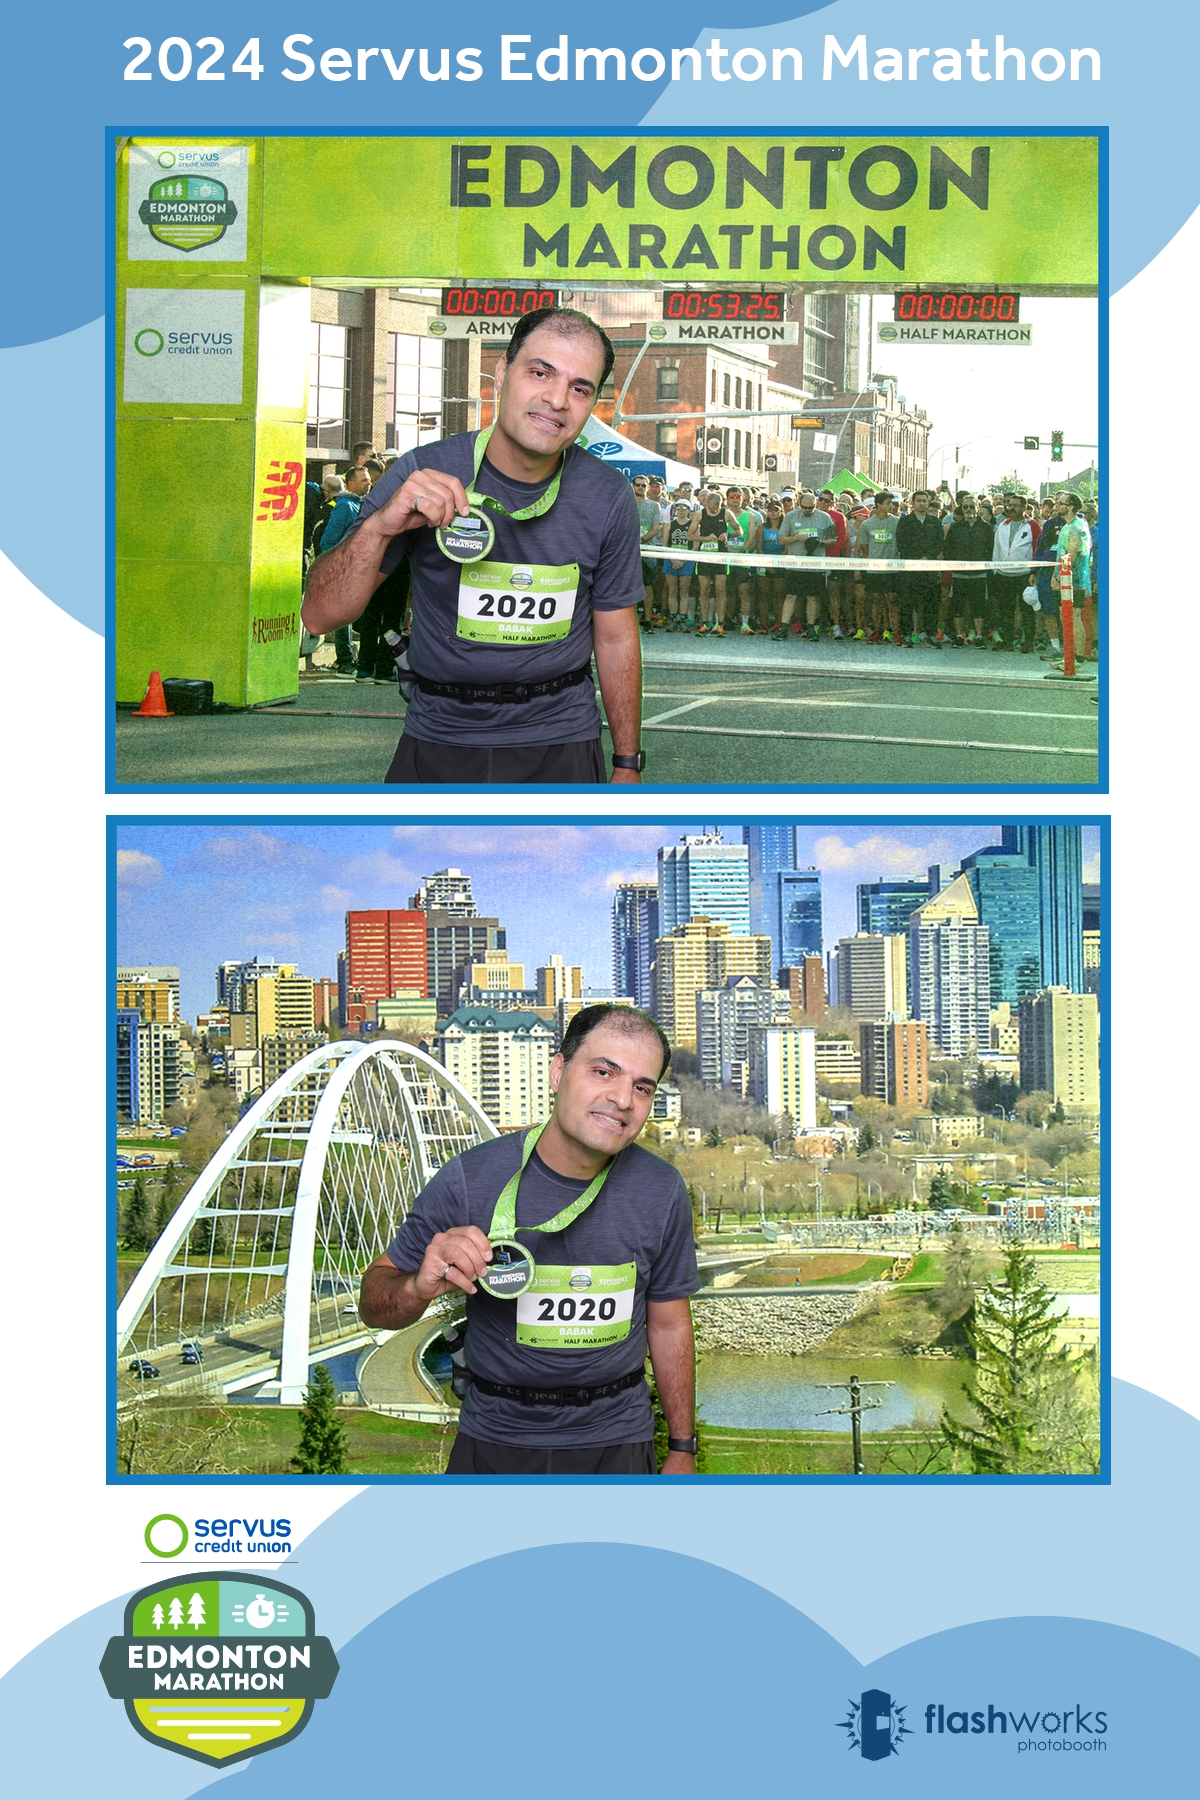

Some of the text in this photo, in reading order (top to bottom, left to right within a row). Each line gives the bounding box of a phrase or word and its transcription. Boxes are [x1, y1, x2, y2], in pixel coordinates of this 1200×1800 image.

[450, 144, 990, 211] EDMONTON
[149, 203, 226, 213] EDMONTON
[160, 214, 215, 222] MARATHON
[523, 222, 906, 272] MARATHON
[168, 332, 233, 345] servus
[678, 324, 785, 340] MARATHON
[900, 328, 939, 340] HALF
[943, 328, 1031, 341] MARATHON
[168, 345, 233, 356] credit union
[477, 593, 557, 620] 2020
[258, 613, 290, 634] Running
[498, 624, 534, 634] BABAK
[520, 633, 557, 642] MARATHON
[537, 1297, 617, 1321] 2020
[559, 1327, 595, 1336] BABAK
[581, 1335, 618, 1344] MARATHON
